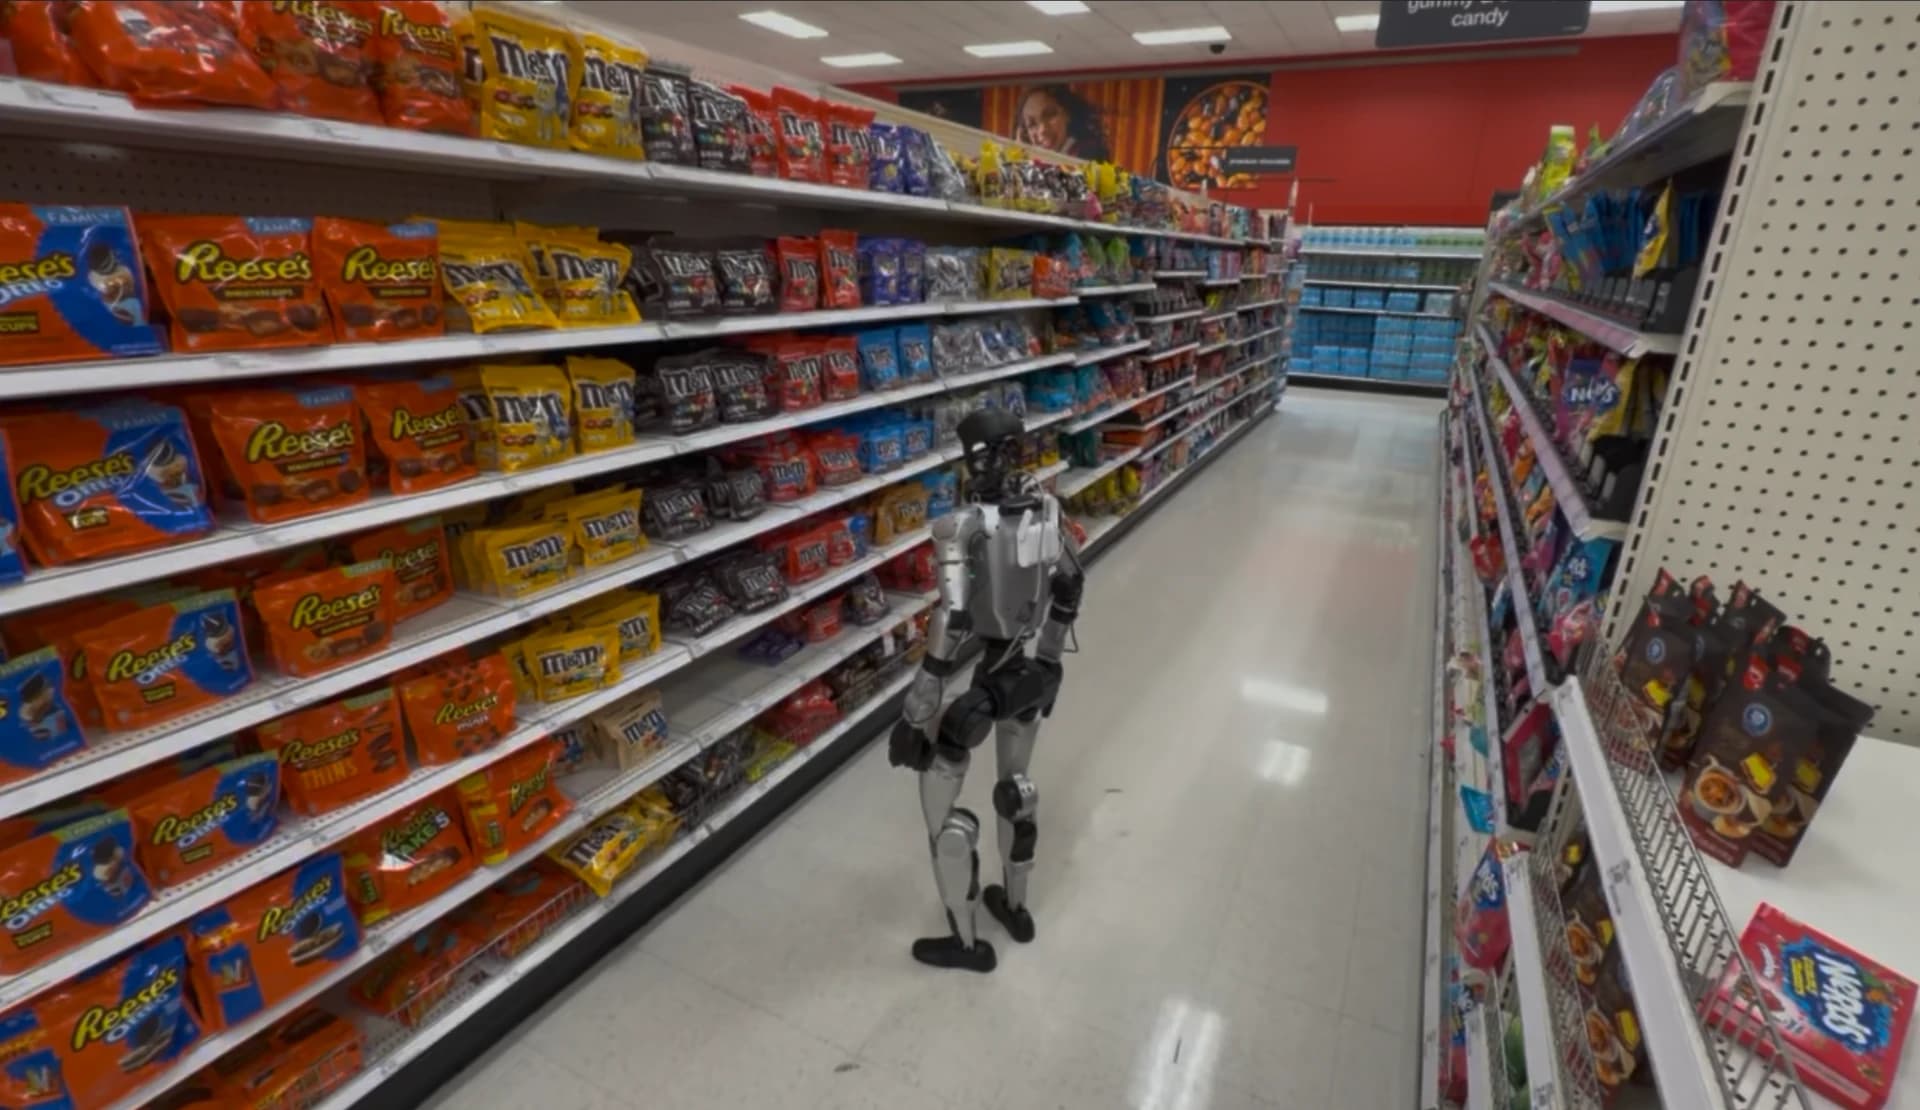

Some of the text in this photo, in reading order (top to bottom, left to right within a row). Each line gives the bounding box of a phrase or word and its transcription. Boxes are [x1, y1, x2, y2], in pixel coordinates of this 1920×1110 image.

[1451, 7, 1509, 27] candy
[0, 253, 76, 284] ese's
[178, 242, 313, 283] Reese's
[248, 421, 354, 462] Reese's
[19, 450, 134, 504] Reese's
[108, 633, 196, 682] Reese's
[301, 757, 358, 790] THINS
[152, 795, 237, 845] Reese's
[0, 863, 82, 921] eese's
[74, 968, 177, 1050] Reese's
